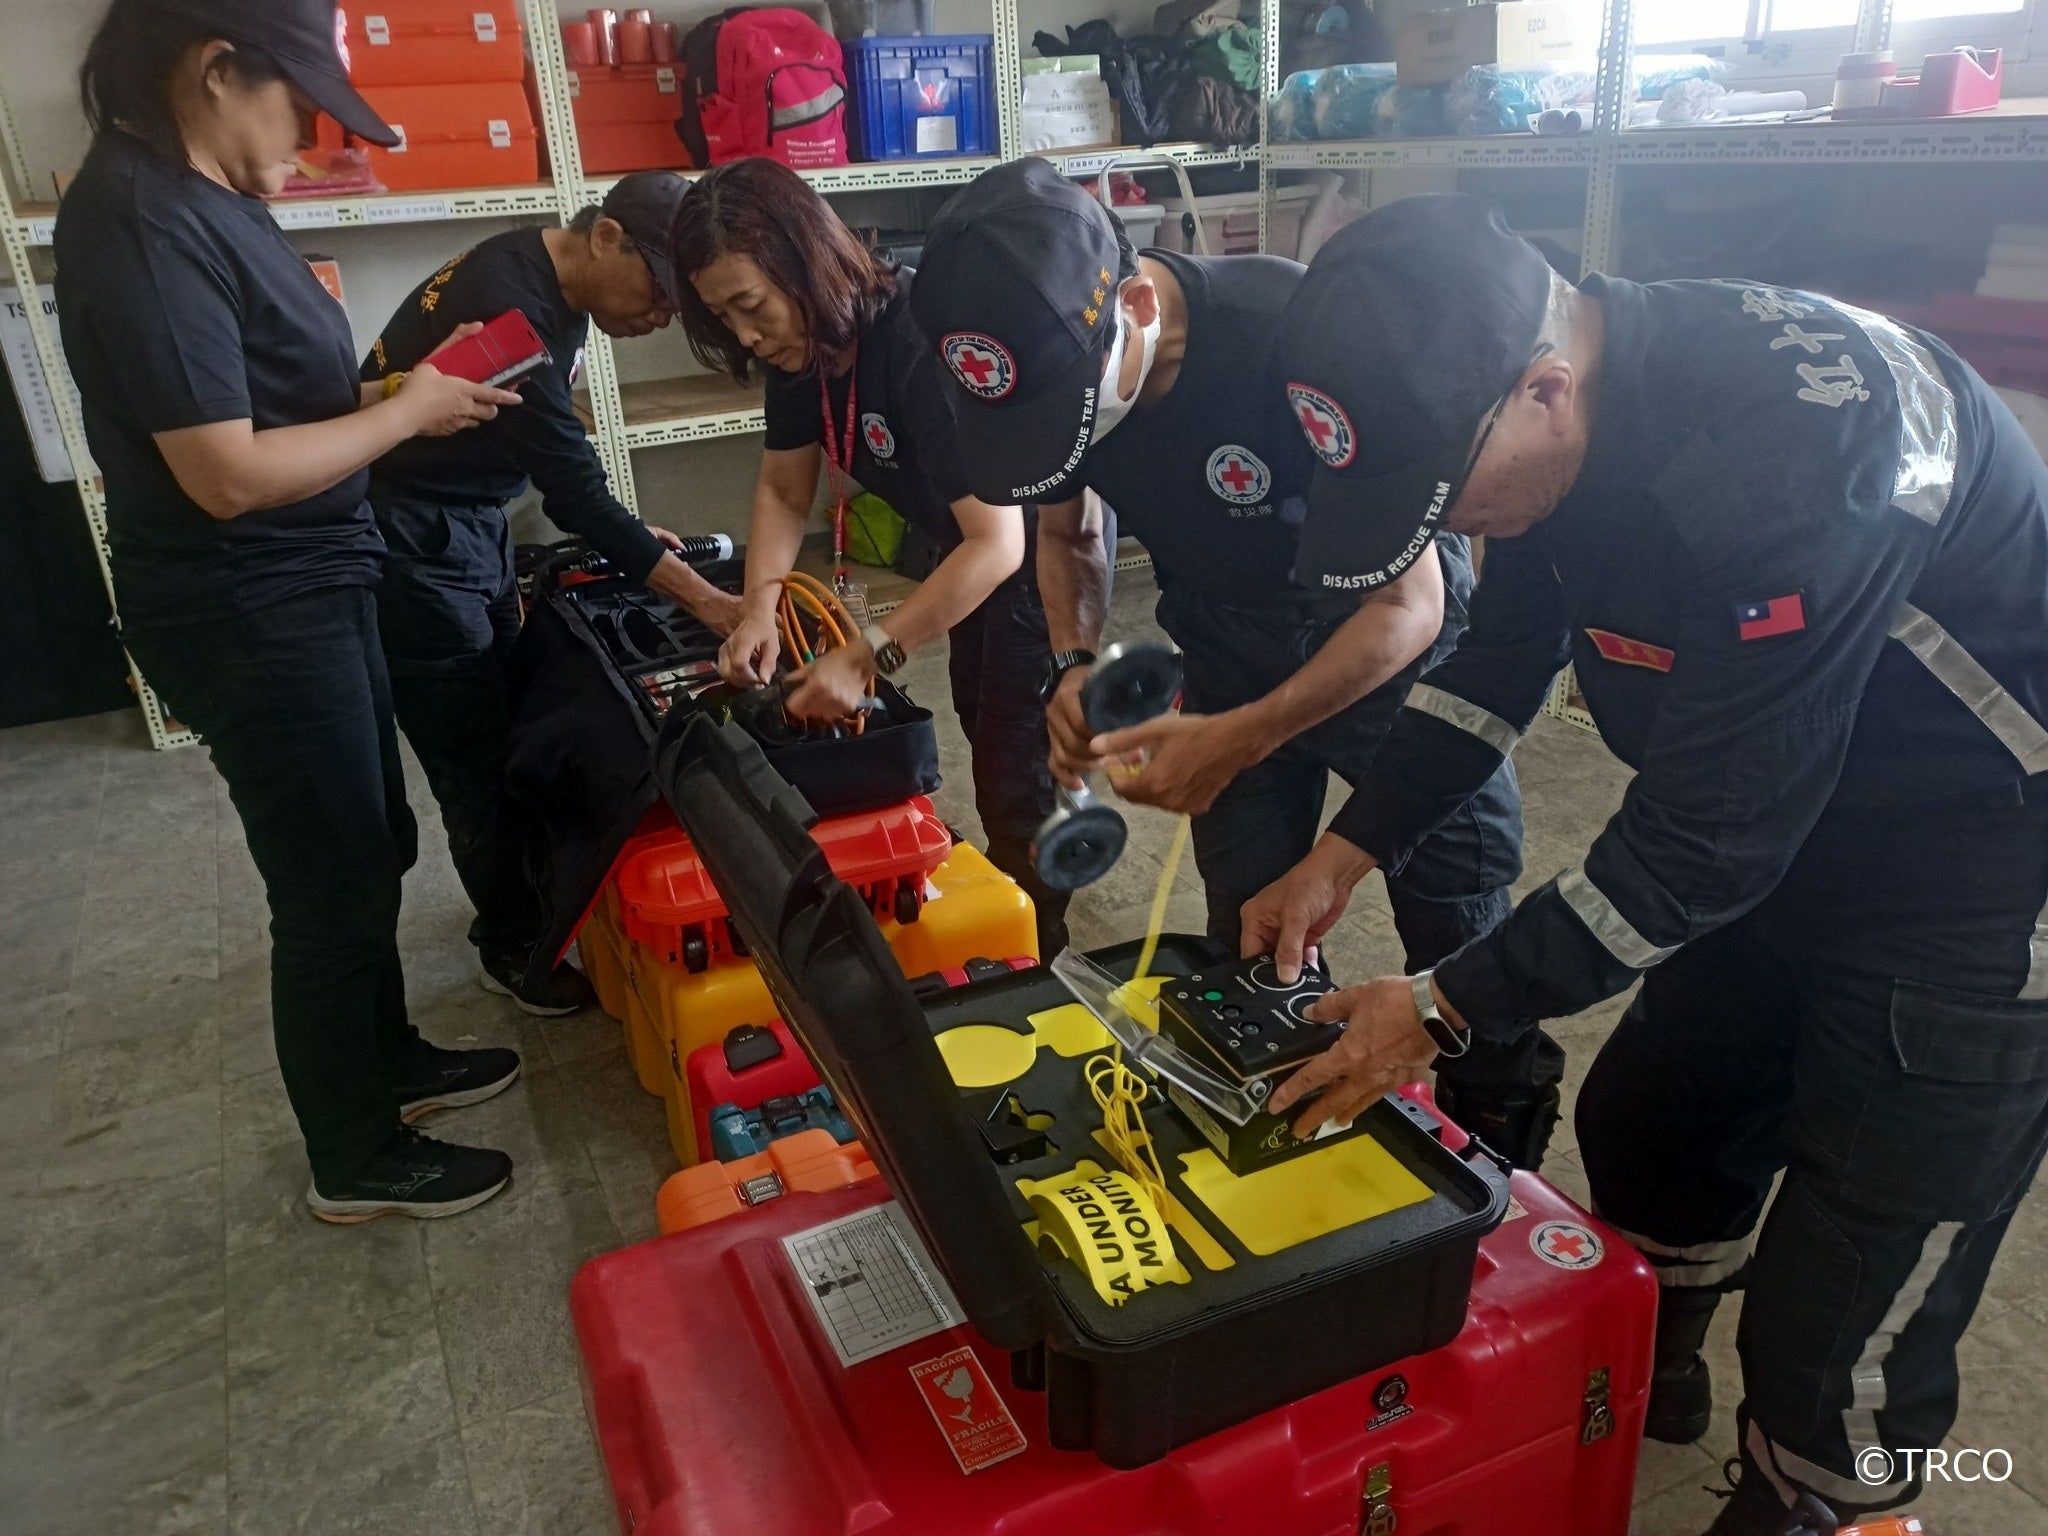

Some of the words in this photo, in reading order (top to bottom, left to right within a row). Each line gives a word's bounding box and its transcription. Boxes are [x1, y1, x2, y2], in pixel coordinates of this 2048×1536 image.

[1012, 471, 1066, 498] DISASTER
[1064, 426, 1090, 472] RESCUE
[1082, 387, 1096, 422] TEAM
[1322, 570, 1387, 589] DISASTER
[1387, 525, 1431, 575] RESCUE
[1424, 481, 1451, 521] TEAM
[1059, 1185, 1124, 1264] UNDER
[1088, 1176, 1164, 1267] MONITO
[915, 1351, 972, 1378] BAGGAGE
[952, 1415, 1006, 1440] FRAGILE
